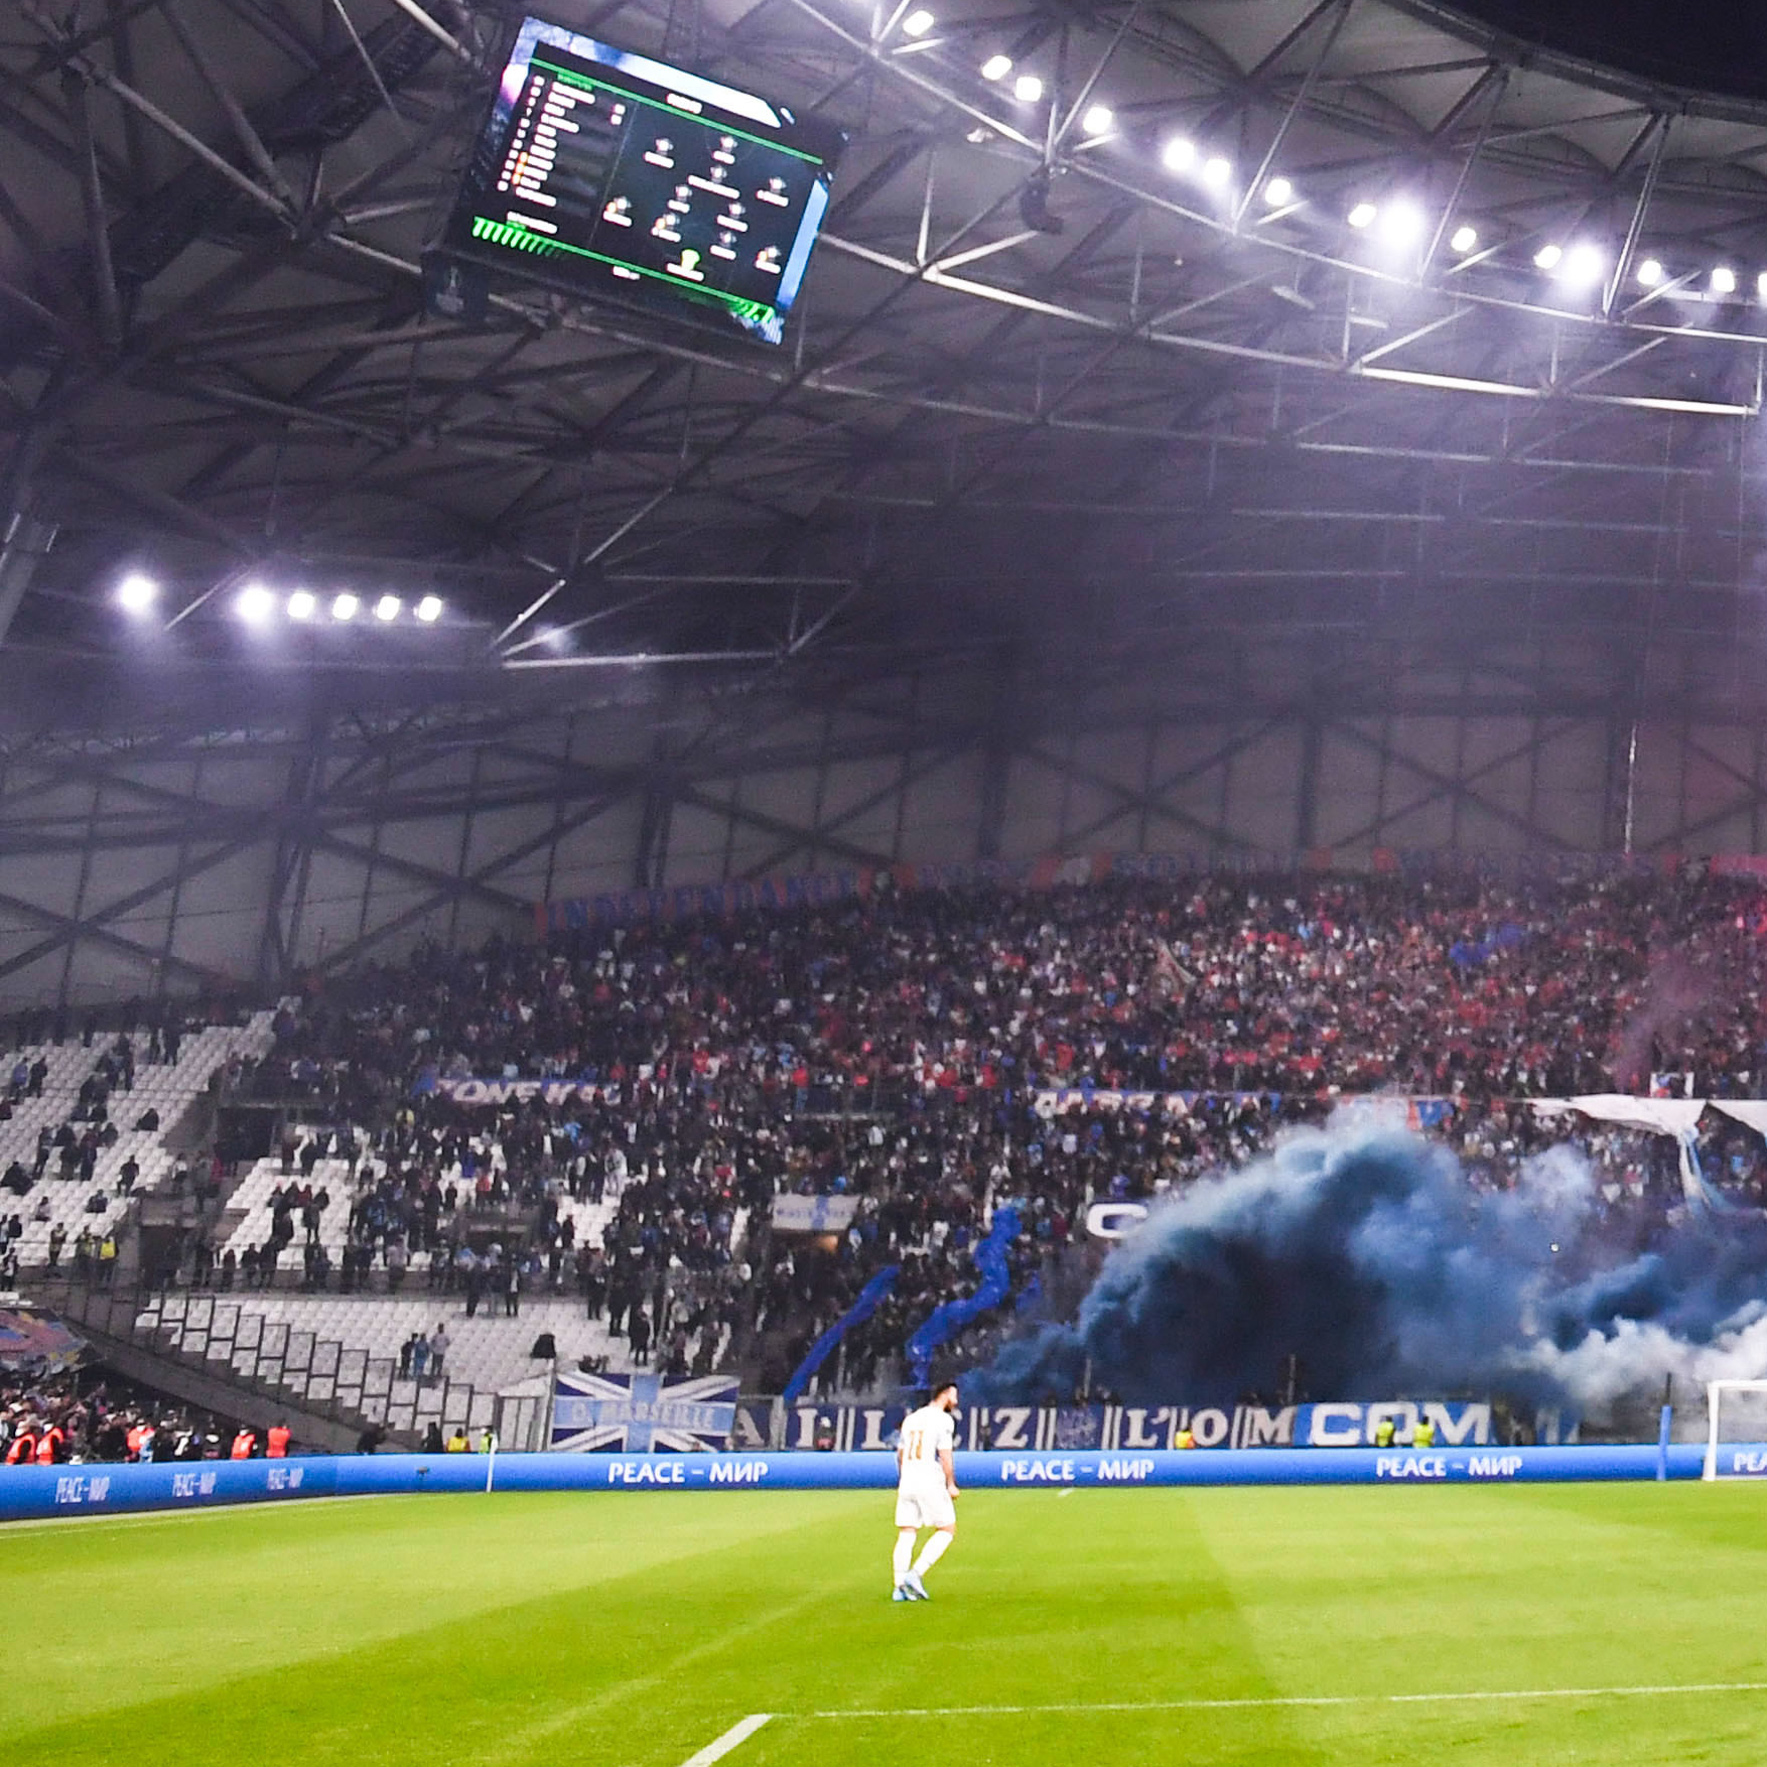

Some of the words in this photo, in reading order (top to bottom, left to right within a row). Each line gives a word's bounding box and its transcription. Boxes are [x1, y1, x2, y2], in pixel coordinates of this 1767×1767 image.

[609, 1461, 685, 1484] PEACE
[709, 1461, 768, 1483] МИР
[1001, 1459, 1075, 1482] PEACE
[1098, 1458, 1155, 1481] МИР
[1376, 1456, 1446, 1478] PEACE
[1468, 1455, 1523, 1477] МИР
